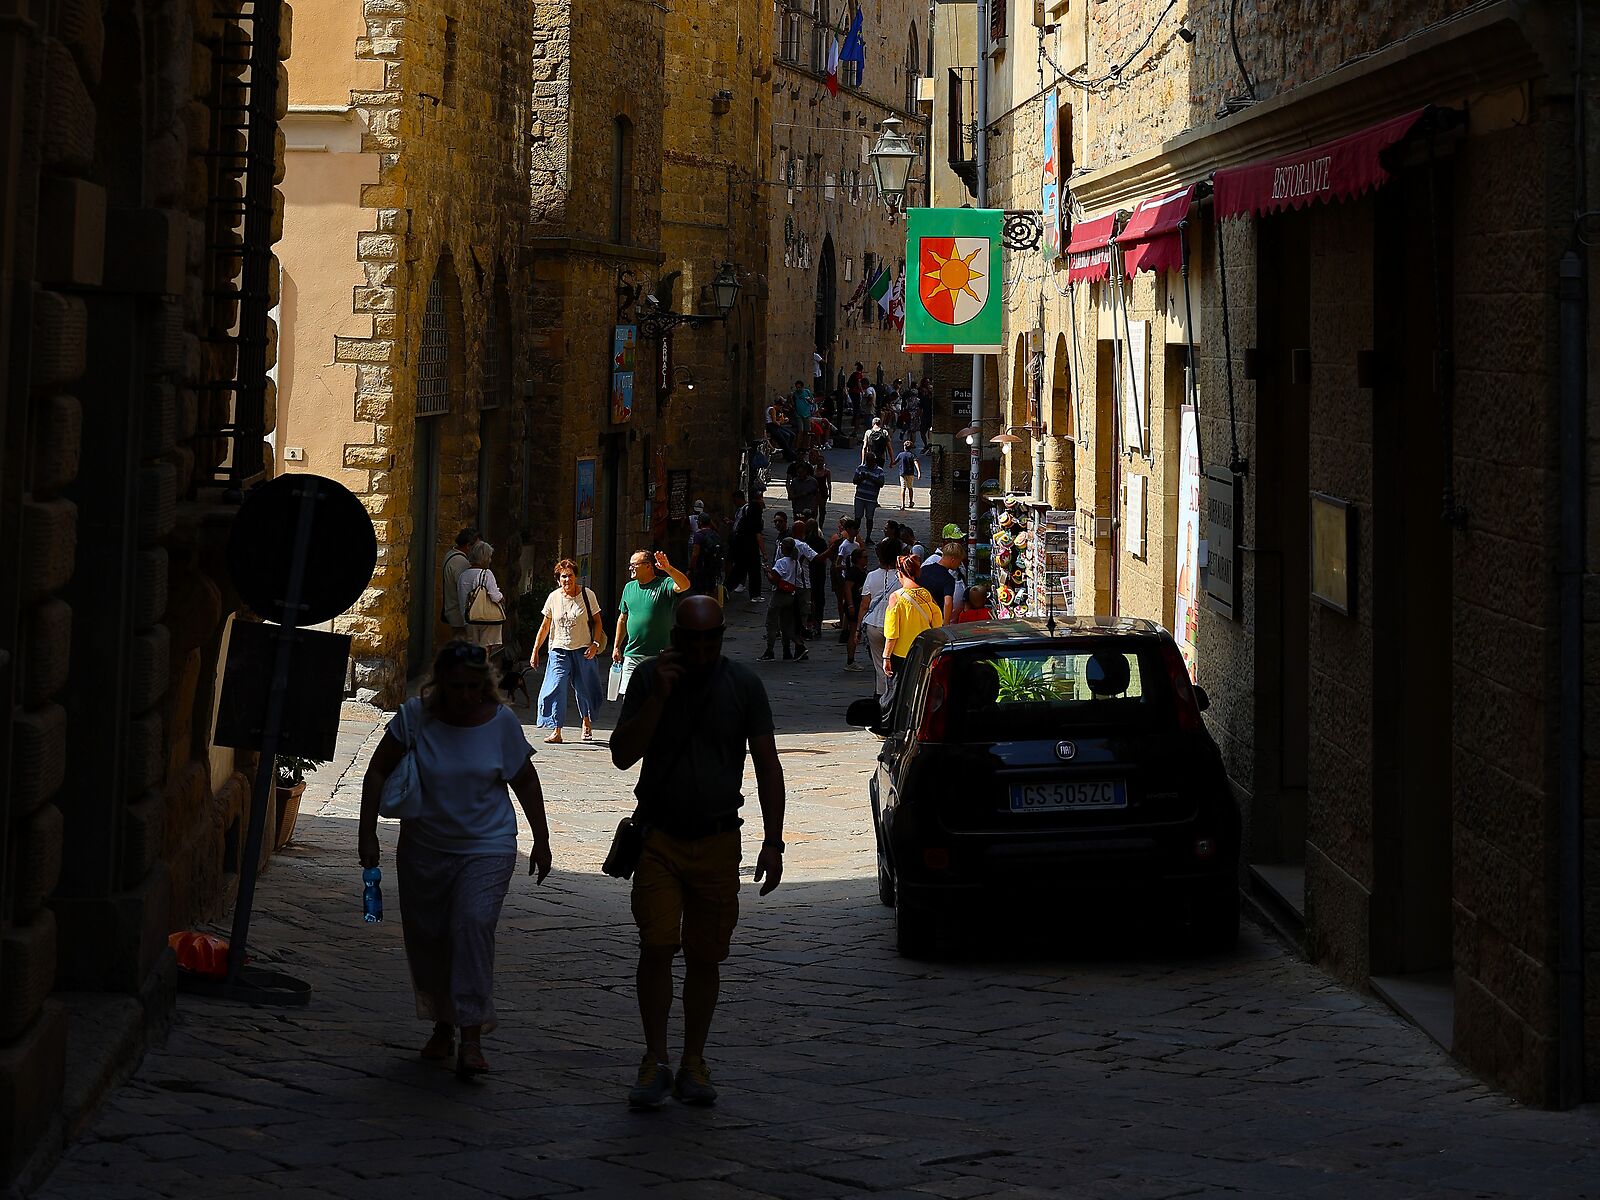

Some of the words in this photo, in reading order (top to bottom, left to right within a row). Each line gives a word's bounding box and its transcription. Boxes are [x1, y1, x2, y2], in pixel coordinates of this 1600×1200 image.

[1272, 157, 1331, 198] RISTORANTE
[954, 390, 971, 398] Pala
[1060, 745, 1072, 755] FIAT
[1024, 786, 1047, 806] GS
[1053, 783, 1111, 804] 505ZC
